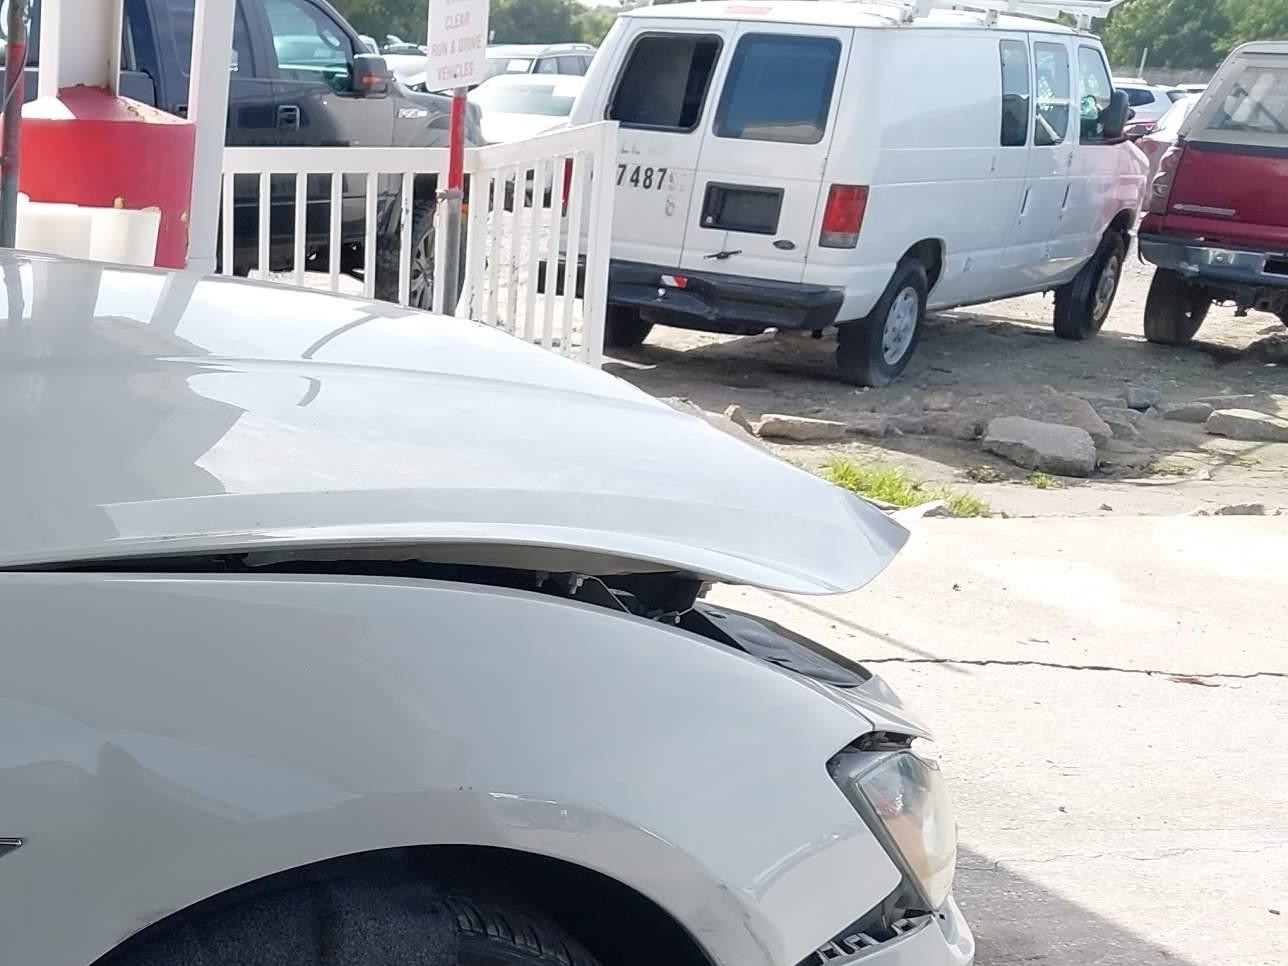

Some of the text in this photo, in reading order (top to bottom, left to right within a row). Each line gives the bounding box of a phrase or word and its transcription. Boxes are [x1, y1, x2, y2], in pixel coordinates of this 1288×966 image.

[445, 11, 470, 30] CLEAR
[458, 34, 482, 52] DRIVE
[438, 61, 474, 80] VEHICLES
